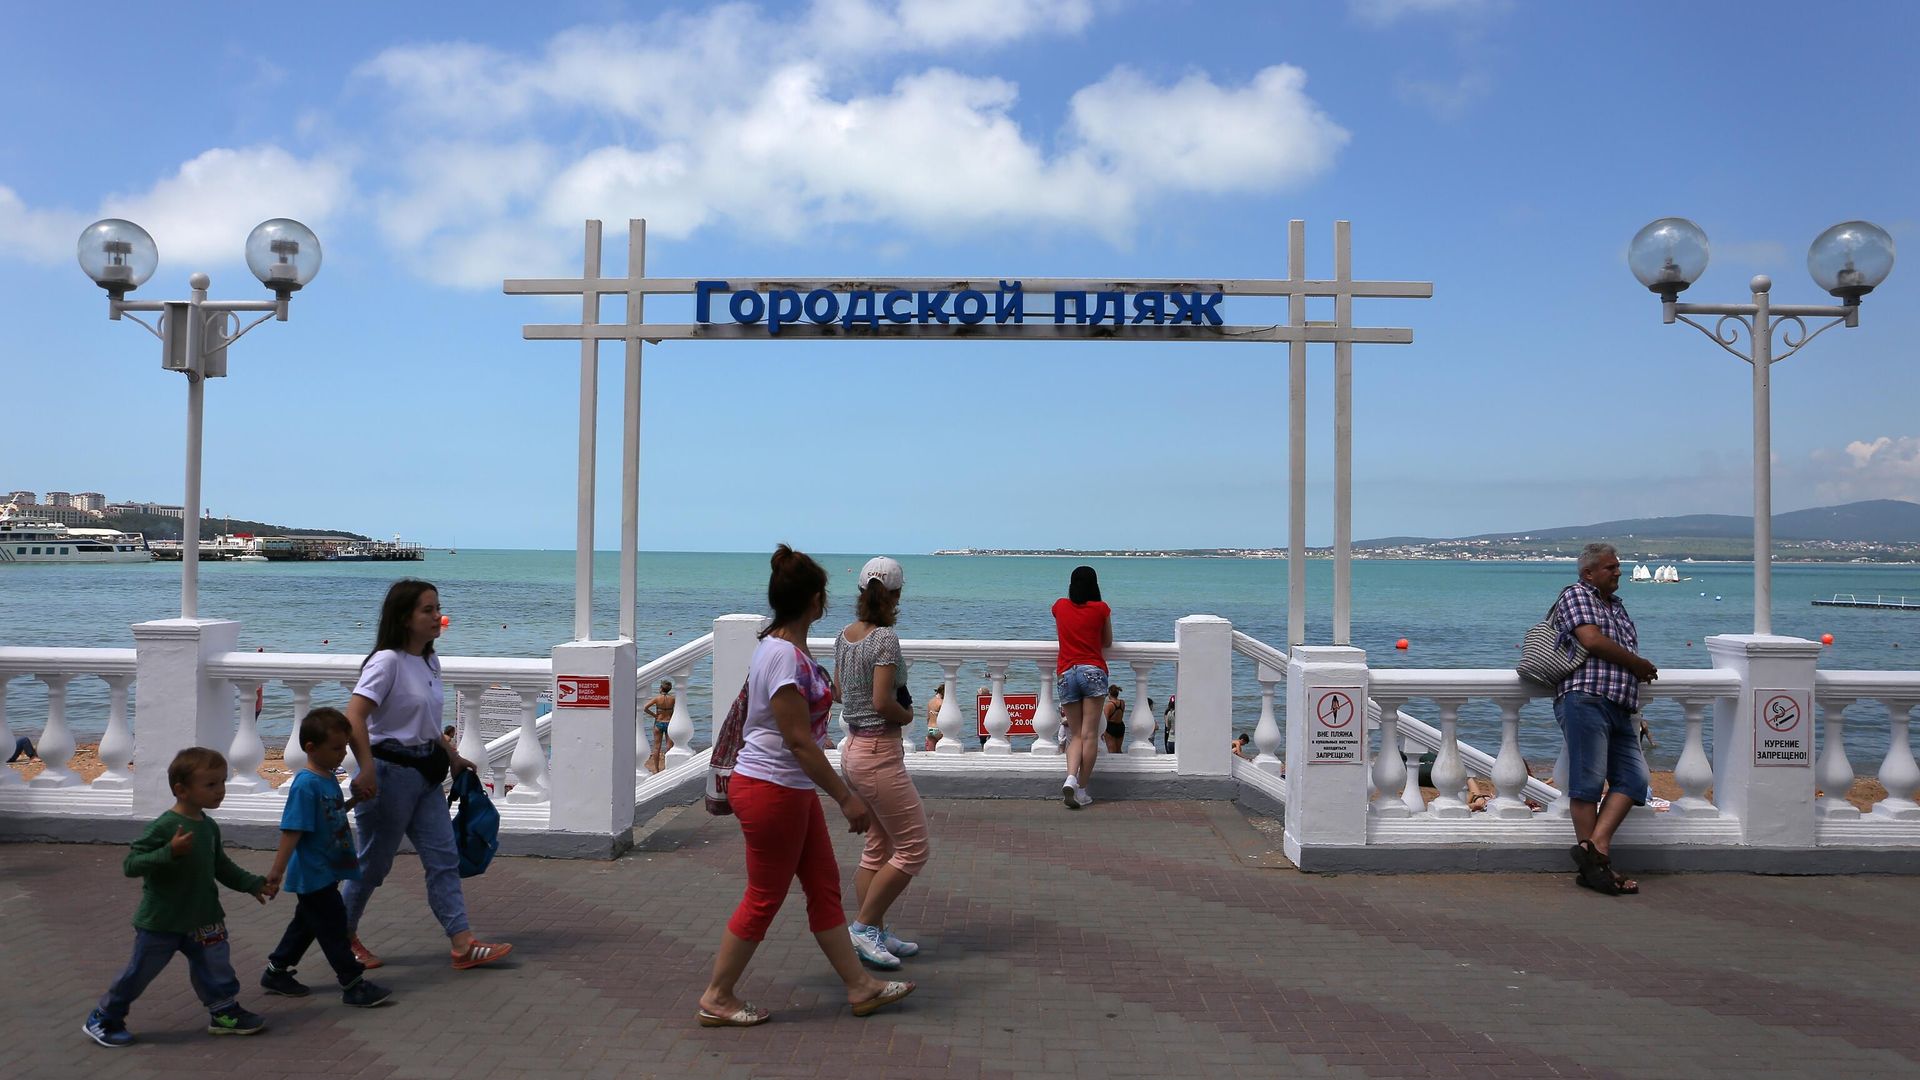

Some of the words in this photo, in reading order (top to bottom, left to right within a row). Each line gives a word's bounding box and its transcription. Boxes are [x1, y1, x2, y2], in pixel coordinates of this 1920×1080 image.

[696, 280, 1024, 335] Городской
[1054, 290, 1224, 326] пляж
[1764, 740, 1800, 748] КУРЕНИЕ
[1757, 751, 1807, 760] ЗАПРЕЩЕНО!
